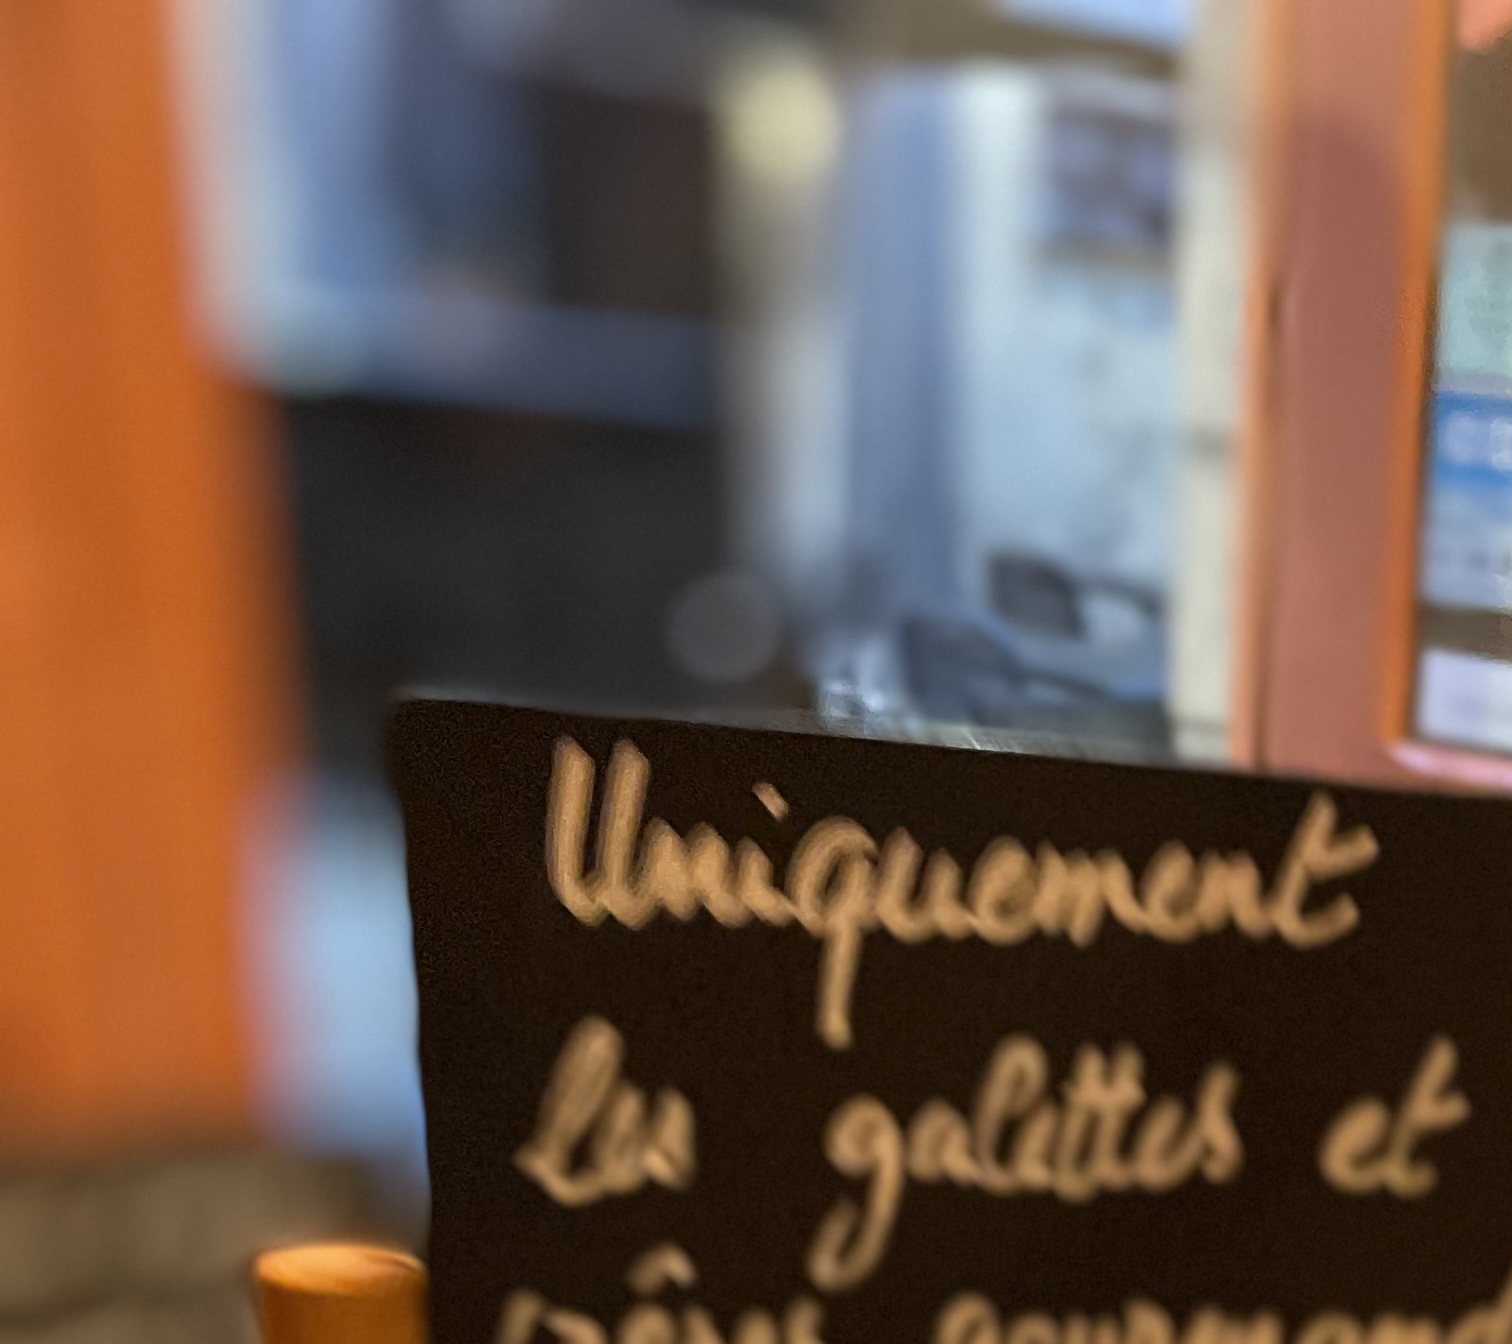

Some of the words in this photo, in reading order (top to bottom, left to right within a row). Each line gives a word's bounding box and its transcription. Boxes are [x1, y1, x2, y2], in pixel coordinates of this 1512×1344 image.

[543, 735, 1378, 1048] Uniquement
[807, 1032, 1244, 1291] galettes
[1318, 1036, 1470, 1198] et
